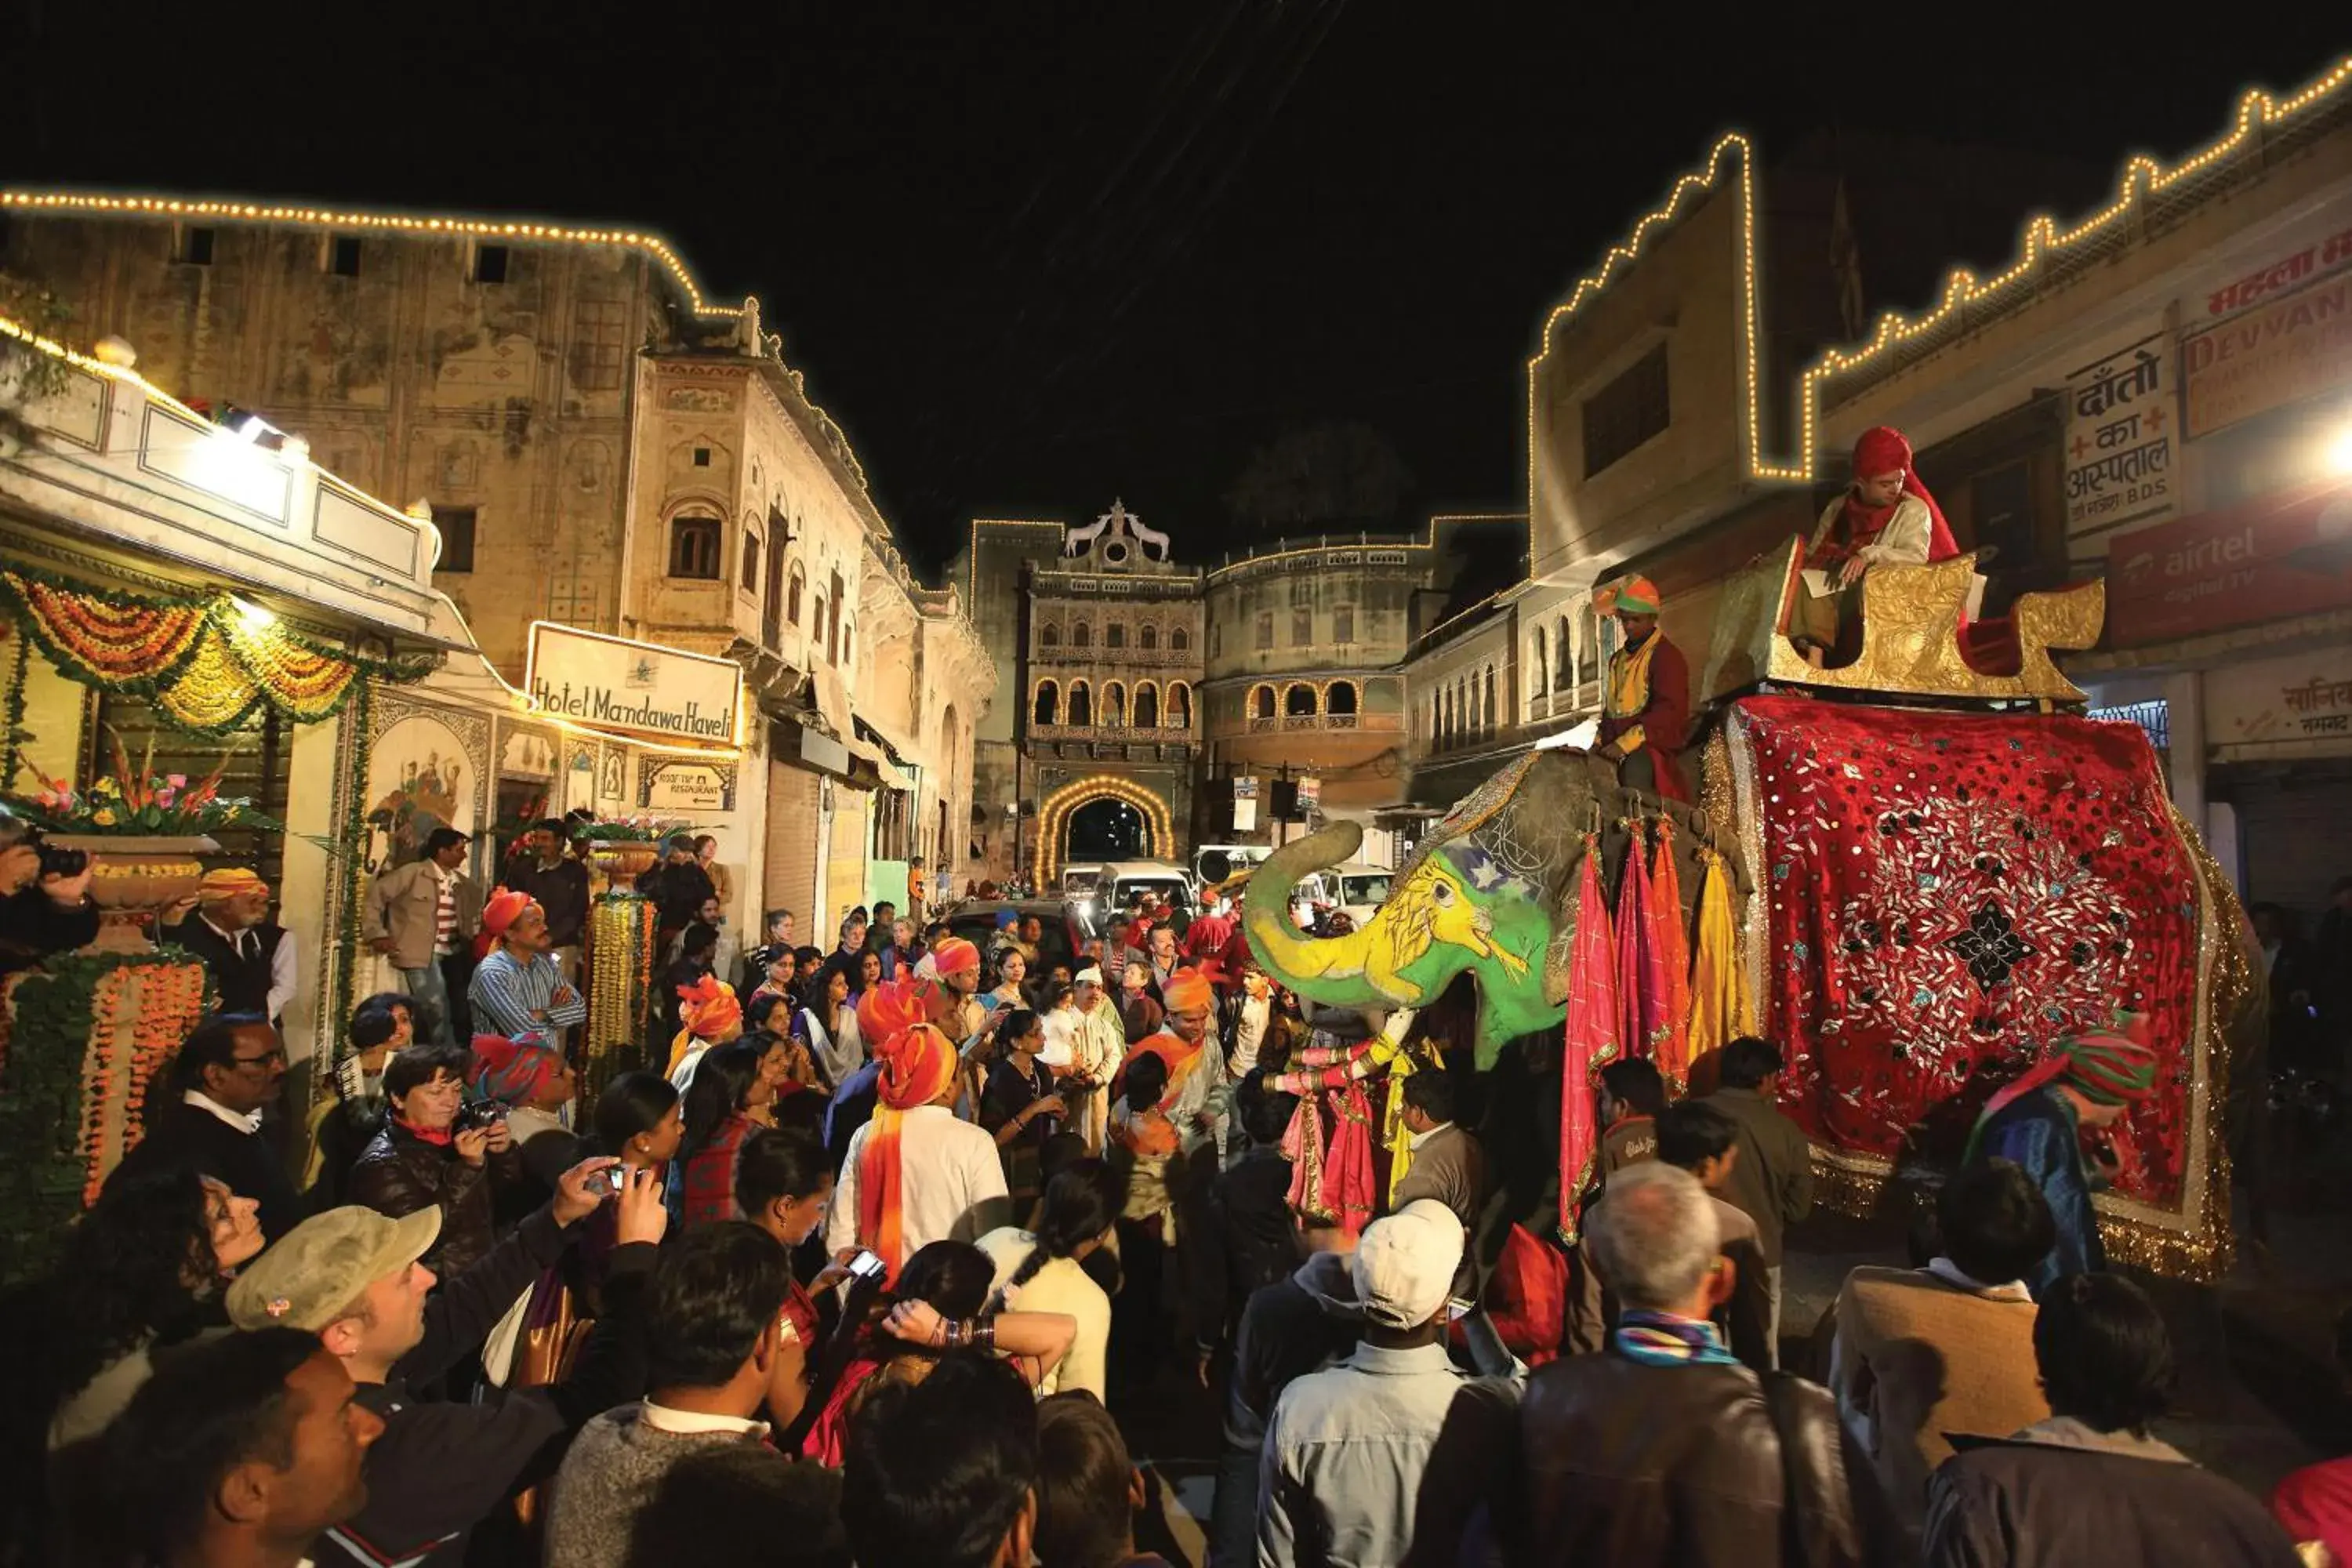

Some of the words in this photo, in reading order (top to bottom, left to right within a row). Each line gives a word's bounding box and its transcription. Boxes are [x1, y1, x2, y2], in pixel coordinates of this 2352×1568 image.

[2096, 415, 2140, 449] का
[2067, 437, 2169, 499] अस्पताल
[2165, 526, 2254, 577] airtel
[2230, 568, 2258, 590] TV
[535, 677, 590, 717] Hotel
[593, 686, 681, 731] Mandawa
[684, 700, 731, 738] Haveli
